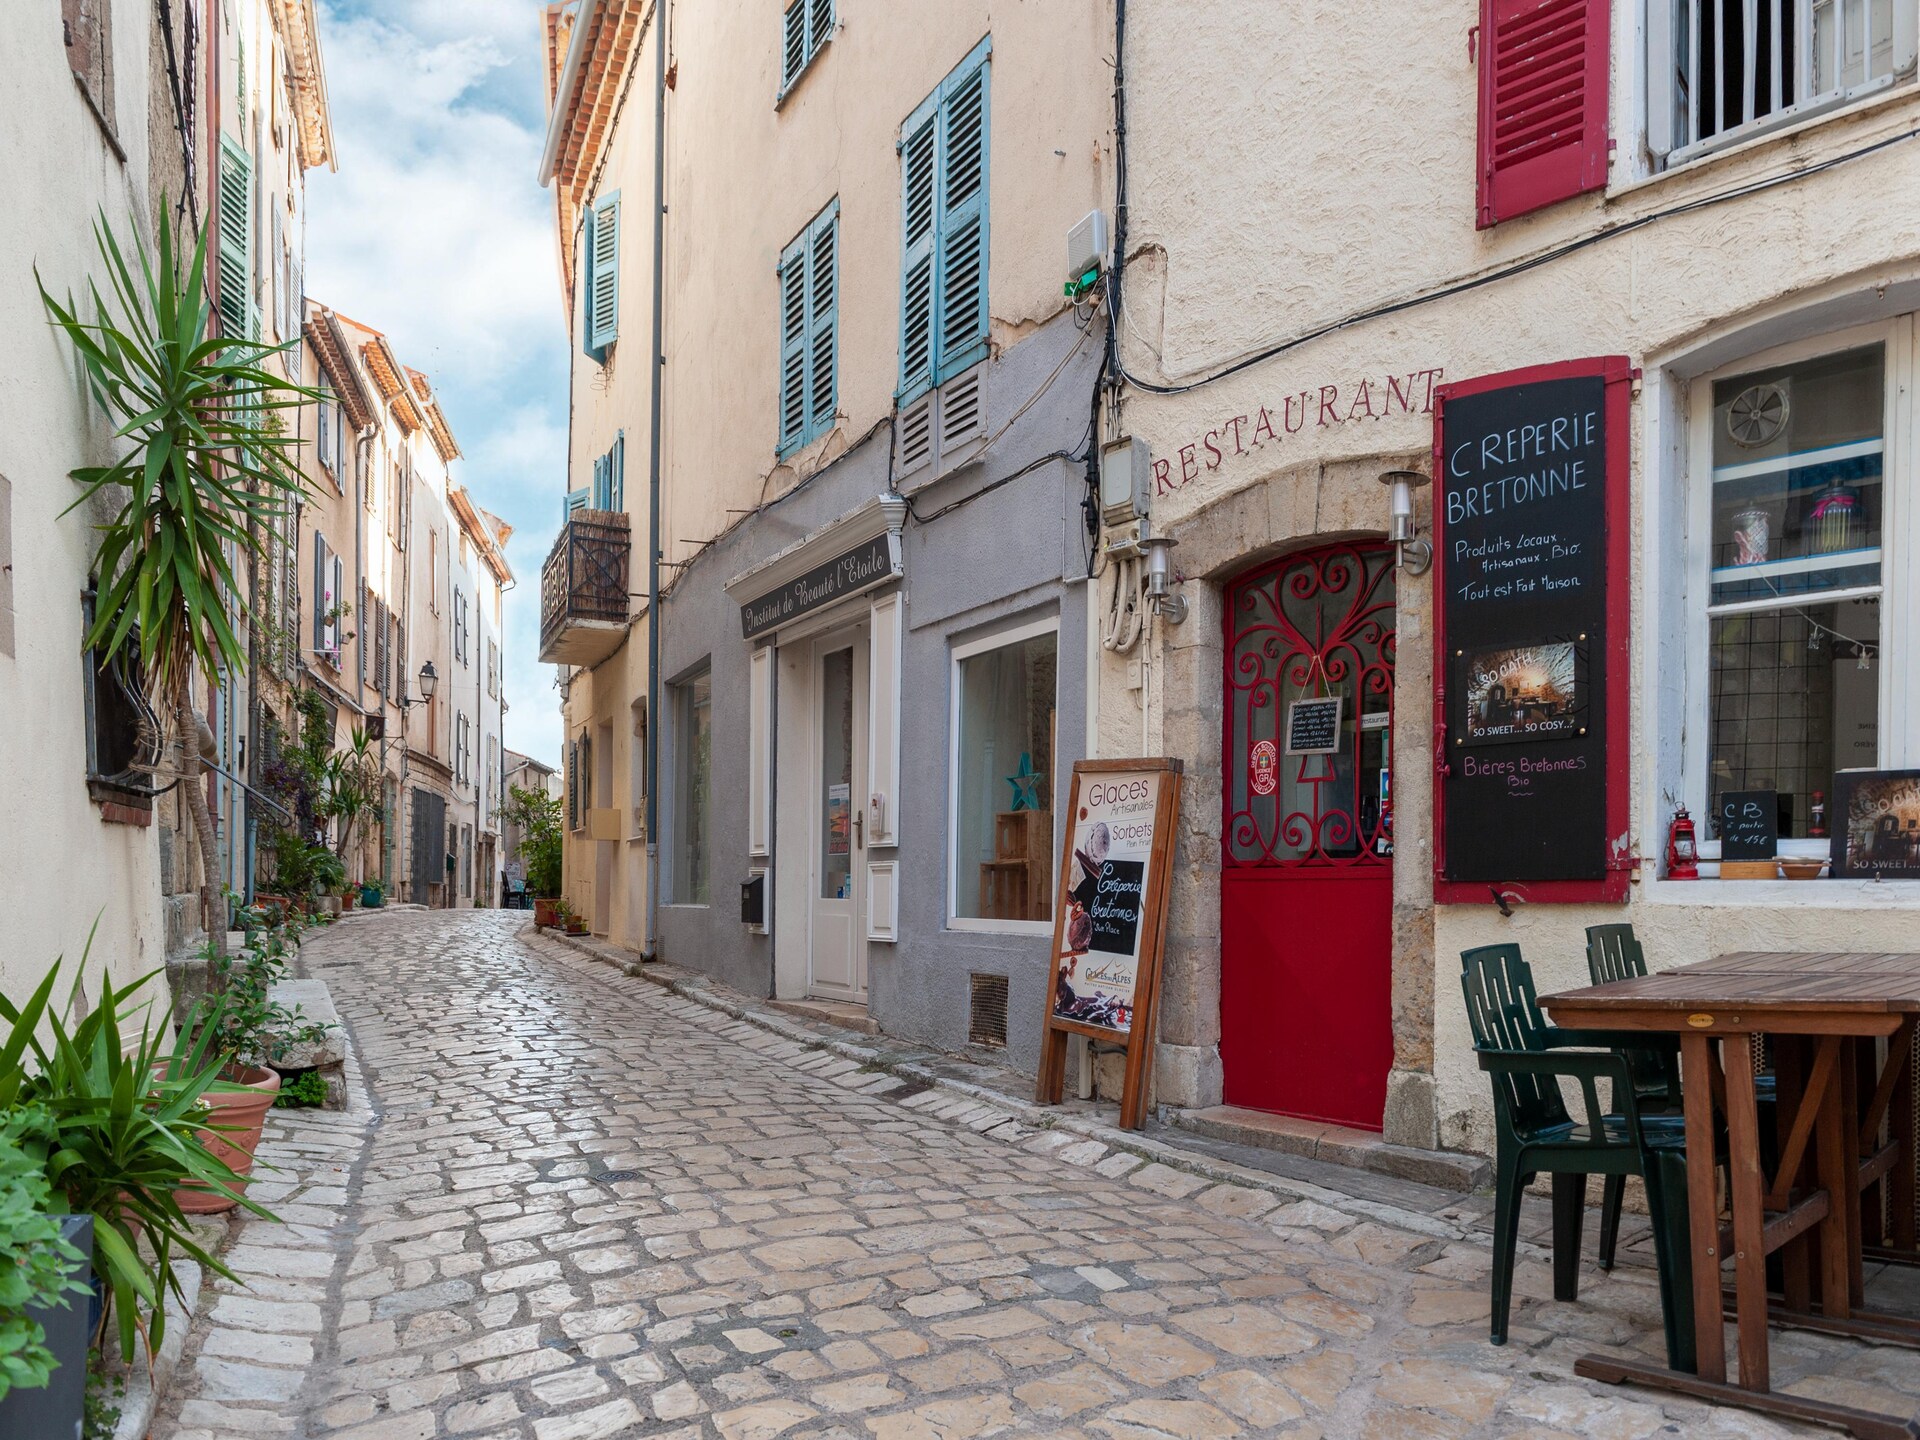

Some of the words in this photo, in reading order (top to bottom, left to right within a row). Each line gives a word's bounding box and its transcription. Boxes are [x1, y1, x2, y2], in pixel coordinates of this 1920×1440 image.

[1151, 367, 1445, 498] RESTAURANT
[1451, 411, 1597, 478] CREPERIE
[1447, 459, 1588, 525] BRETONNE
[1455, 534, 1512, 563] Produits
[1516, 533, 1558, 549] Locaux
[1482, 553, 1541, 574] Artisanaux
[1458, 581, 1490, 601] Tout
[1493, 581, 1513, 597] est
[1516, 578, 1536, 593] Fait
[1541, 574, 1582, 592] Maison
[745, 602, 781, 632] Institut
[782, 591, 794, 615] de
[794, 576, 835, 607] Beauté
[1480, 670, 1499, 687] SO
[1473, 727, 1486, 738] SO
[1525, 722, 1538, 733] SO
[1463, 755, 1516, 777] Bières
[1519, 755, 1587, 774] Bretonnes
[1258, 773, 1270, 783] GR
[1507, 774, 1530, 787] Bio
[1089, 779, 1149, 807] Glaces
[1110, 798, 1154, 817] Artisanales
[1112, 821, 1153, 841] Sorbets
[1738, 820, 1765, 831] partir
[1729, 833, 1740, 843] de
[1853, 859, 1869, 870] SO
[1105, 921, 1121, 936] Place
[1111, 972, 1132, 985] ALPES
